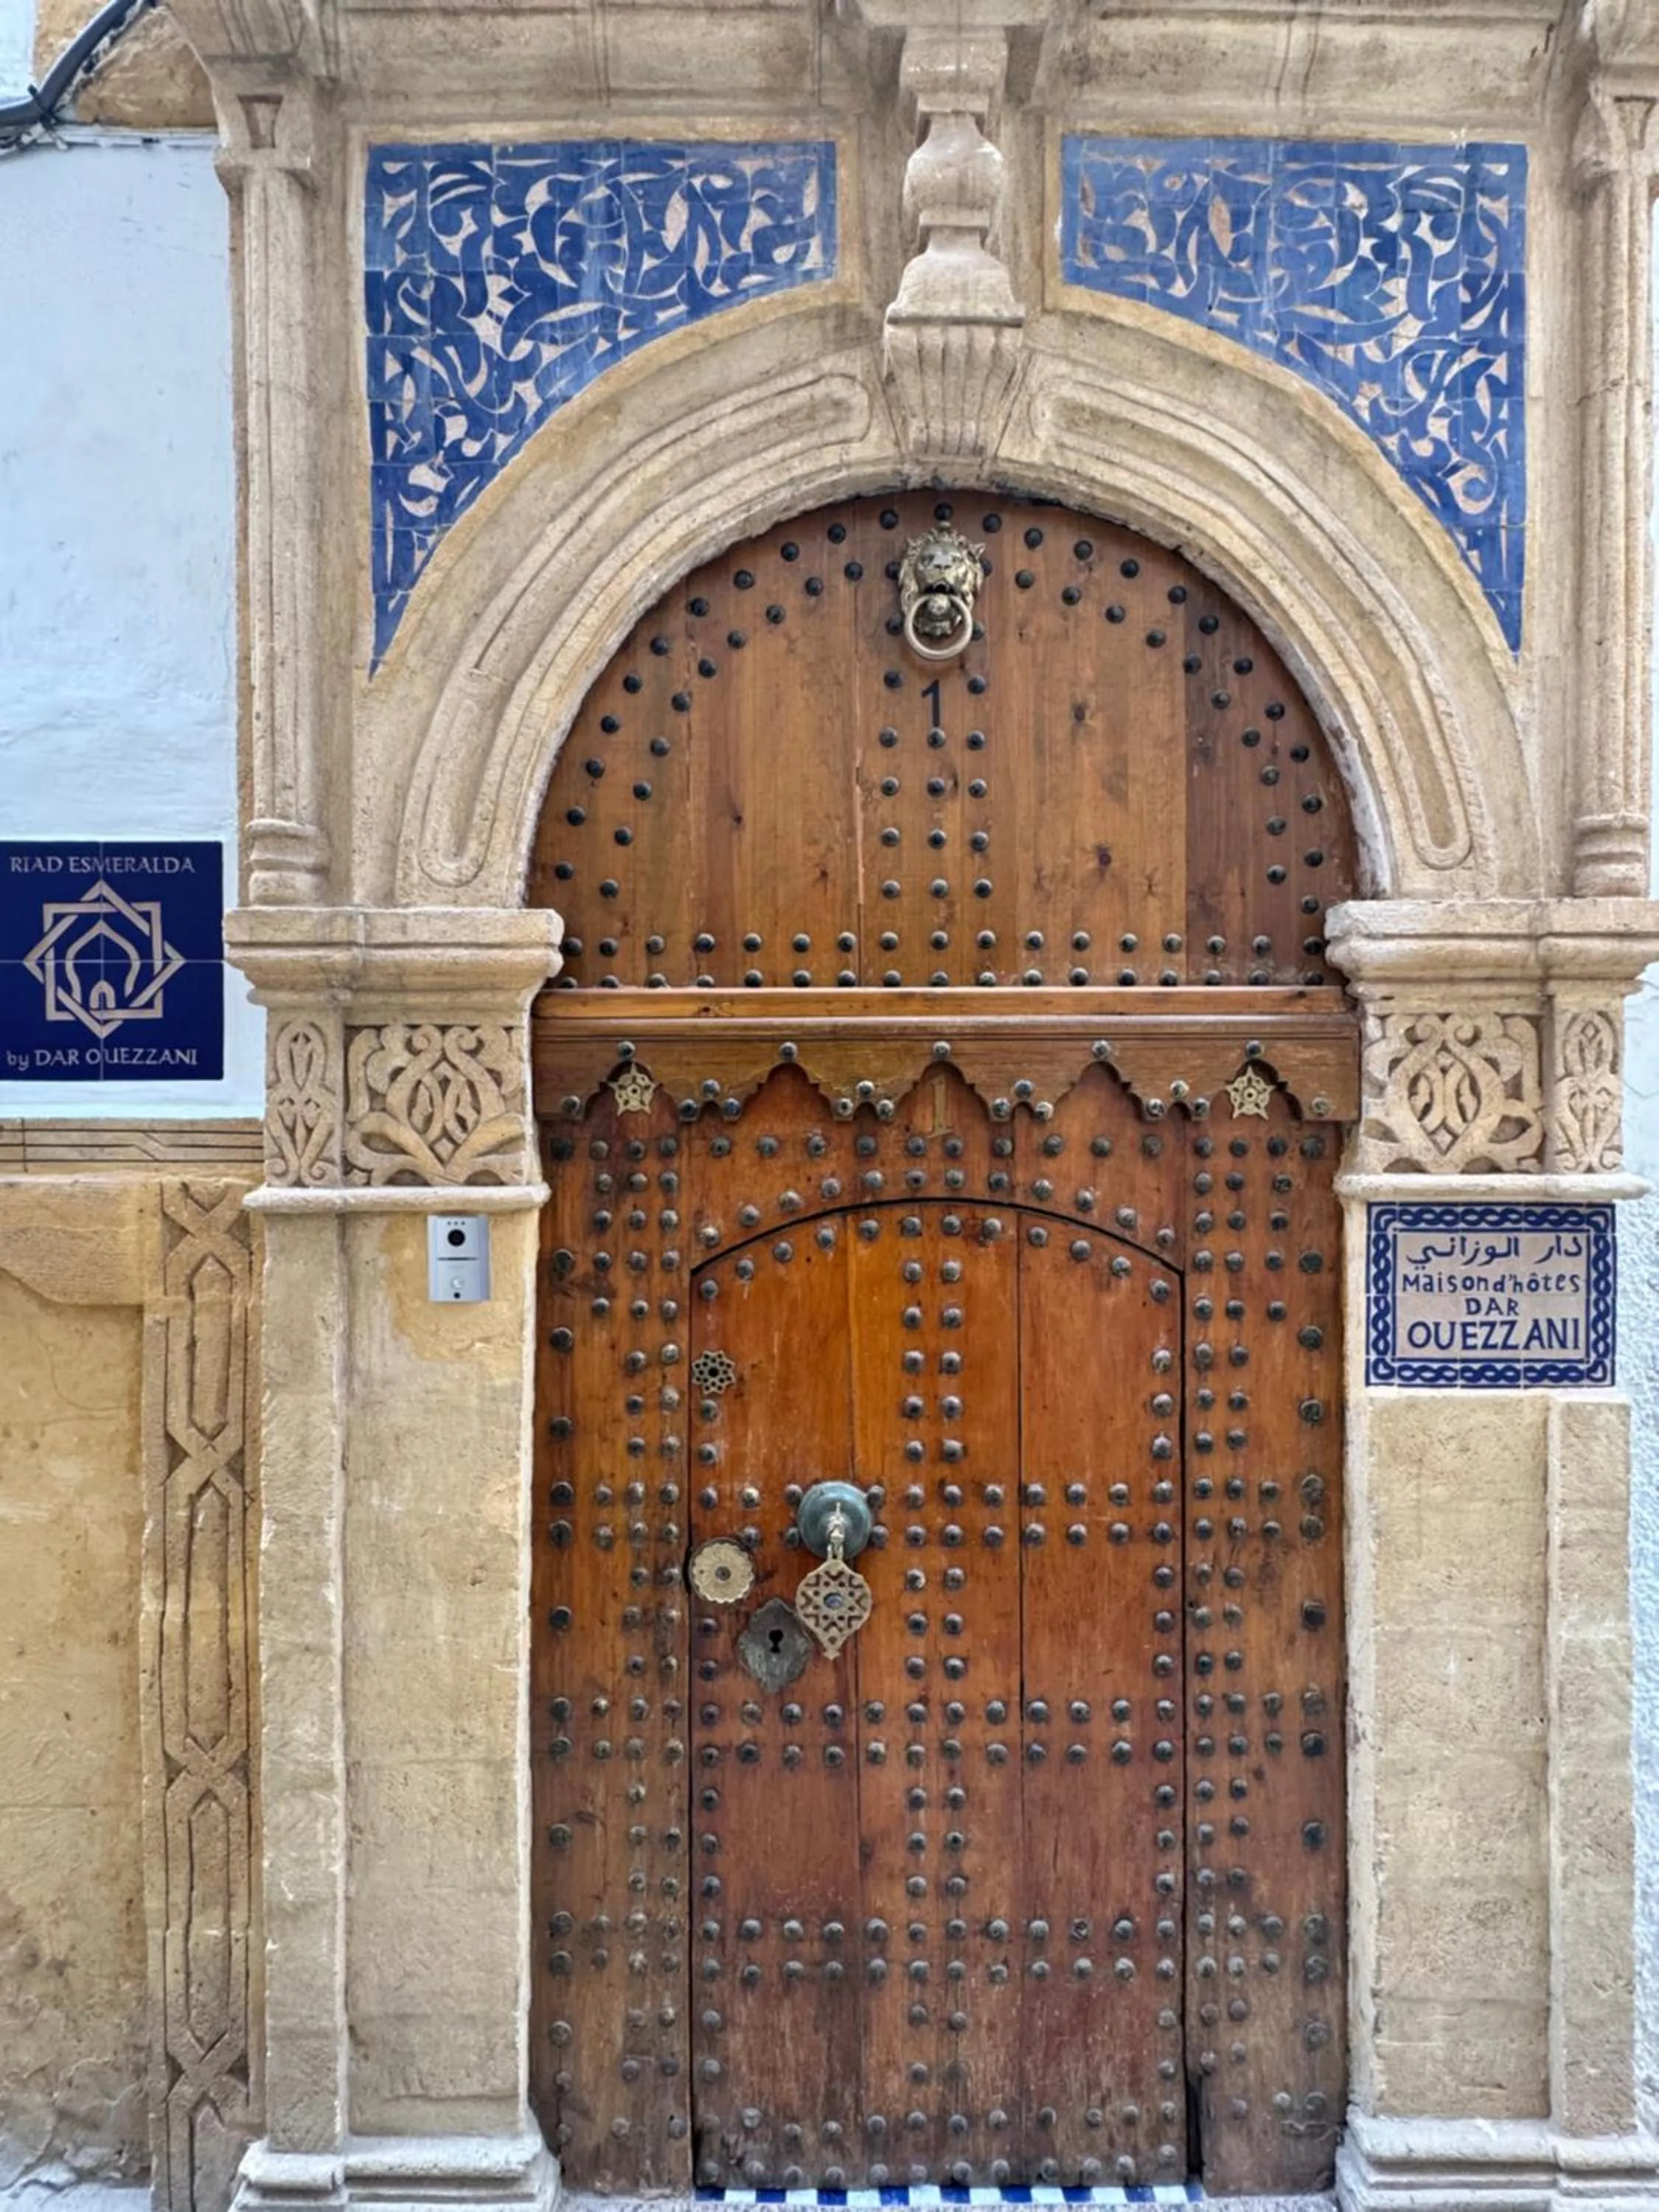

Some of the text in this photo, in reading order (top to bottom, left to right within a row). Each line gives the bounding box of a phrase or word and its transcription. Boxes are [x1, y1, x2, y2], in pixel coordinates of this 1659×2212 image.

[921, 679, 939, 727] 1
[10, 856, 195, 874] RIAD ESMERALDA
[7, 1048, 198, 1071] by DAR OUEZZANI
[1534, 1235, 1582, 1265] دار
[1402, 1272, 1489, 1293] Maison
[1466, 1297, 1520, 1316] DAR
[1408, 1318, 1581, 1350] OUEZZANI
